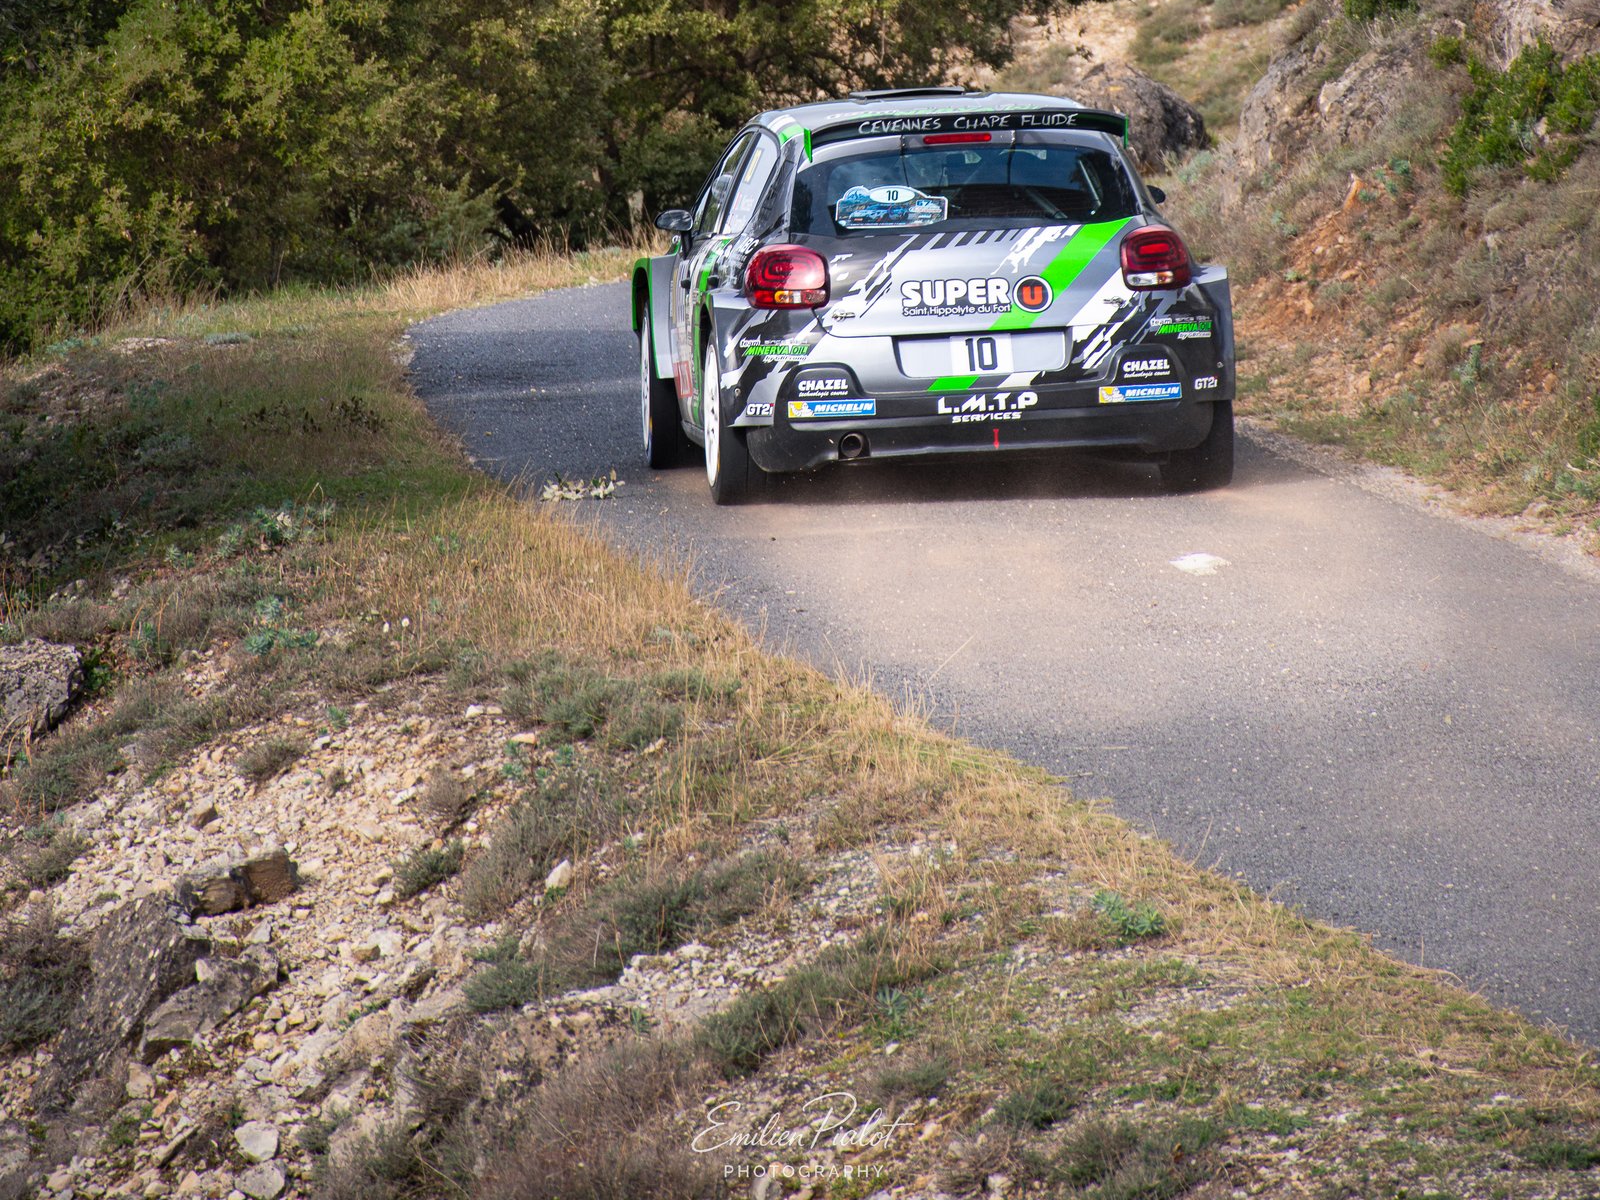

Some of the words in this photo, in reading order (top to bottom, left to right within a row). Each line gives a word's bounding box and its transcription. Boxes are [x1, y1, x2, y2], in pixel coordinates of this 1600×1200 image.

[858, 117, 941, 135] CEVENNES
[953, 114, 1010, 130] CHAPE
[1021, 113, 1079, 127] FLUIDE
[886, 190, 898, 201] 10
[901, 278, 1011, 306] SUPER
[1023, 286, 1043, 305] U
[903, 306, 928, 316] Saint
[929, 305, 976, 317] Hippolyte
[978, 304, 991, 314] du
[992, 303, 1012, 314] Fort
[1150, 318, 1172, 327] team
[1158, 323, 1198, 335] MINERVA
[740, 335, 761, 348] team
[745, 346, 789, 356] MINERVA
[791, 345, 809, 355] OIL
[965, 337, 998, 372] 10
[1123, 359, 1170, 372] CHAZEL
[798, 379, 848, 391] CHAZEL
[1194, 376, 1218, 390] GT2i
[1125, 388, 1179, 397] MICHELIN
[747, 403, 774, 415] GT2i
[814, 402, 874, 412] MICHELIN
[952, 411, 1022, 424] SERVICES
